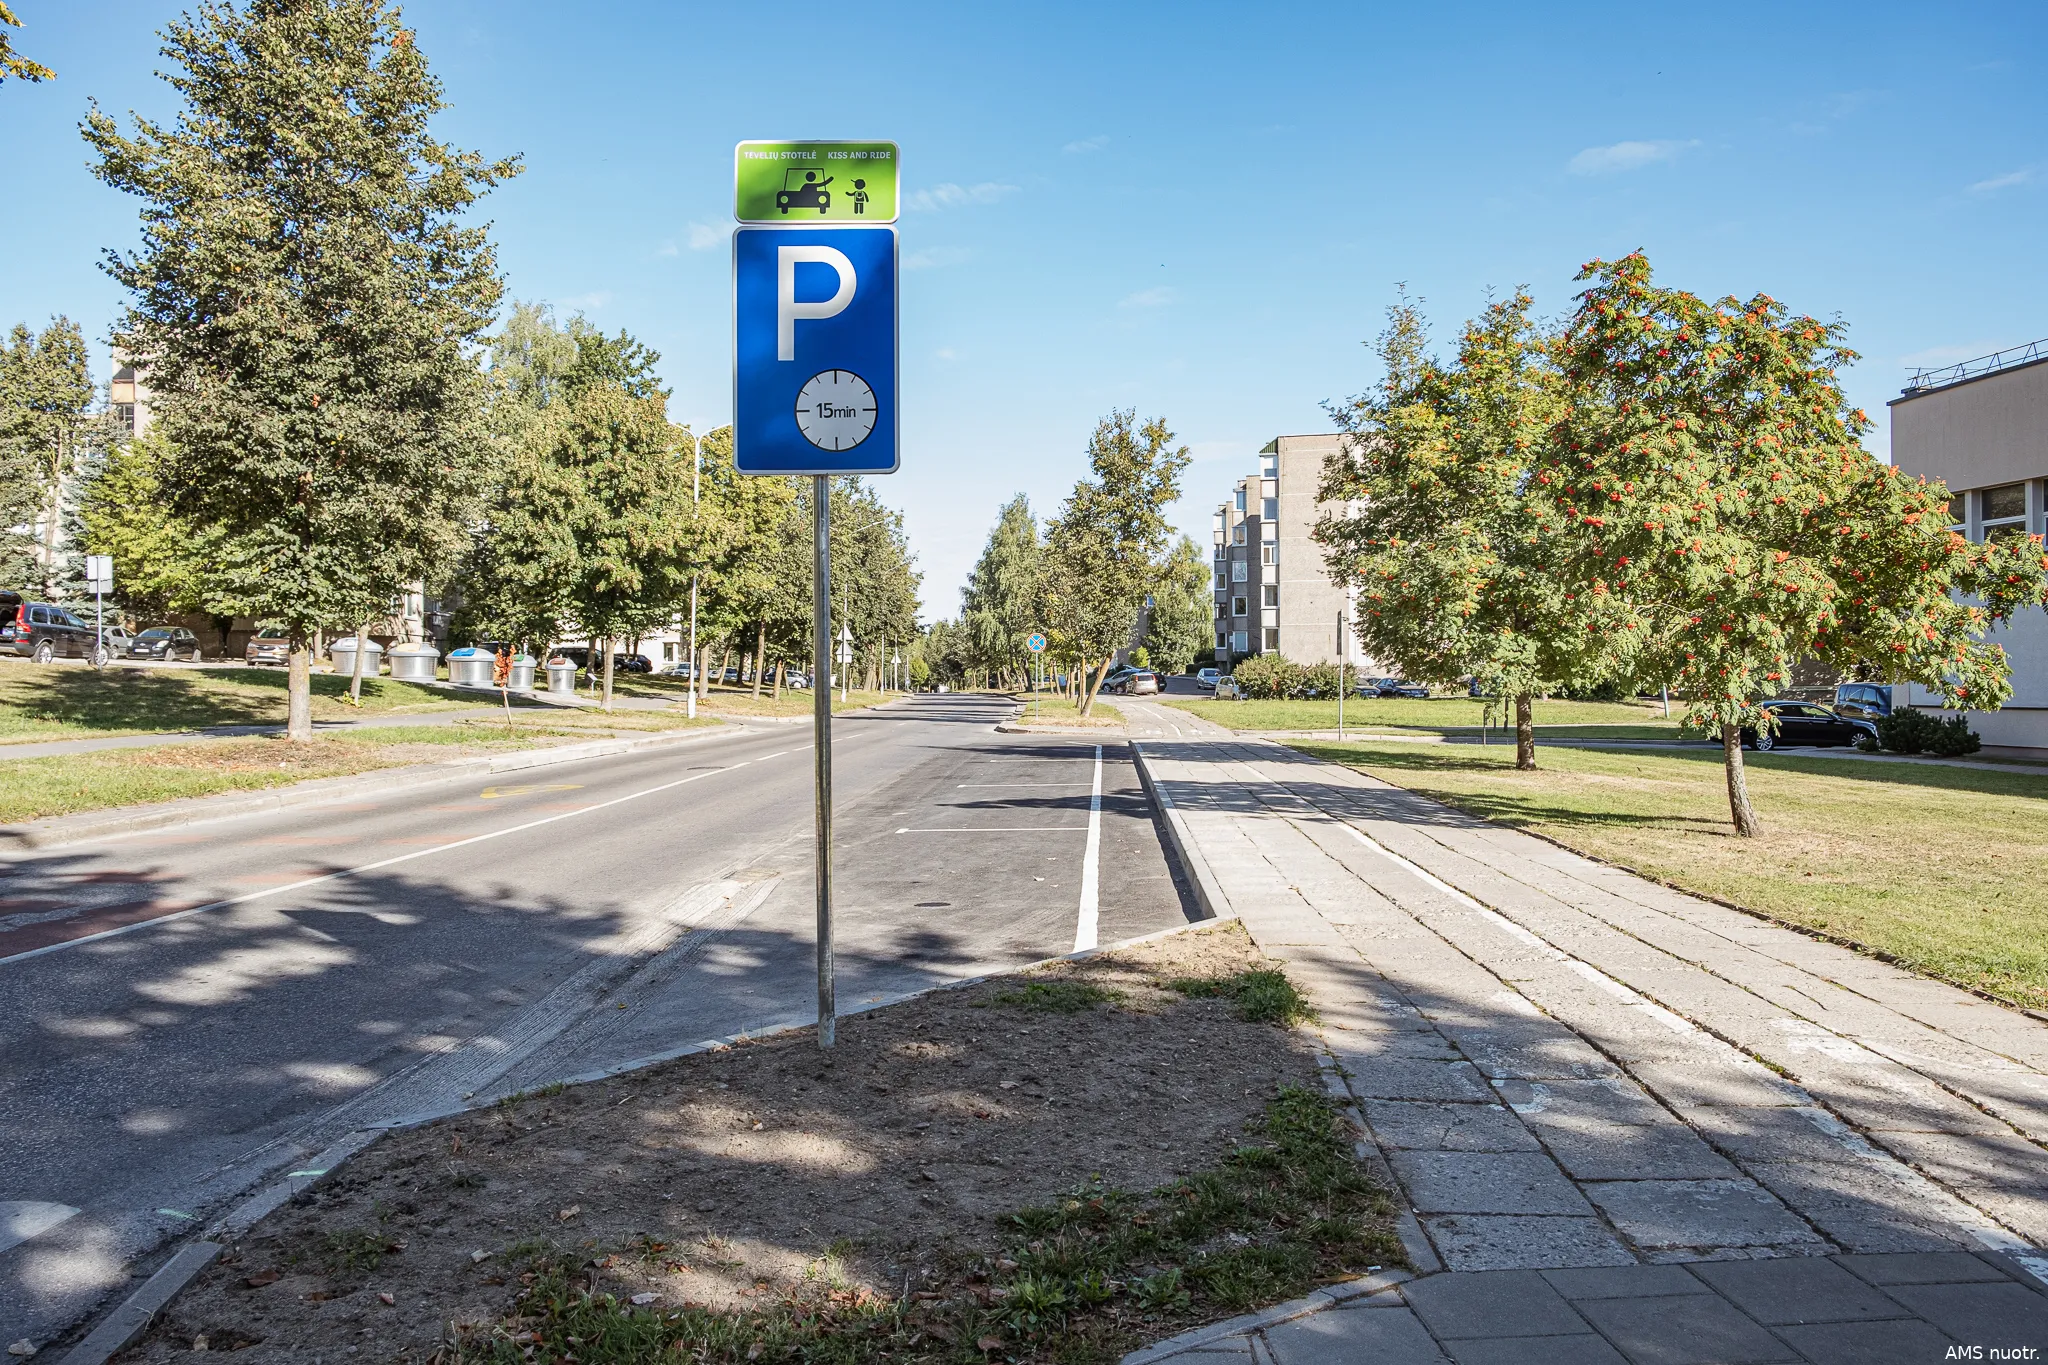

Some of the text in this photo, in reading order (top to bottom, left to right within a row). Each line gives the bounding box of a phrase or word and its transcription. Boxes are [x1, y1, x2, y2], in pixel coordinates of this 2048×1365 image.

[780, 150, 817, 160] STOTELĖ
[827, 151, 891, 160] KISS AND RIDE
[778, 246, 857, 361] P
[816, 402, 856, 418] 15min
